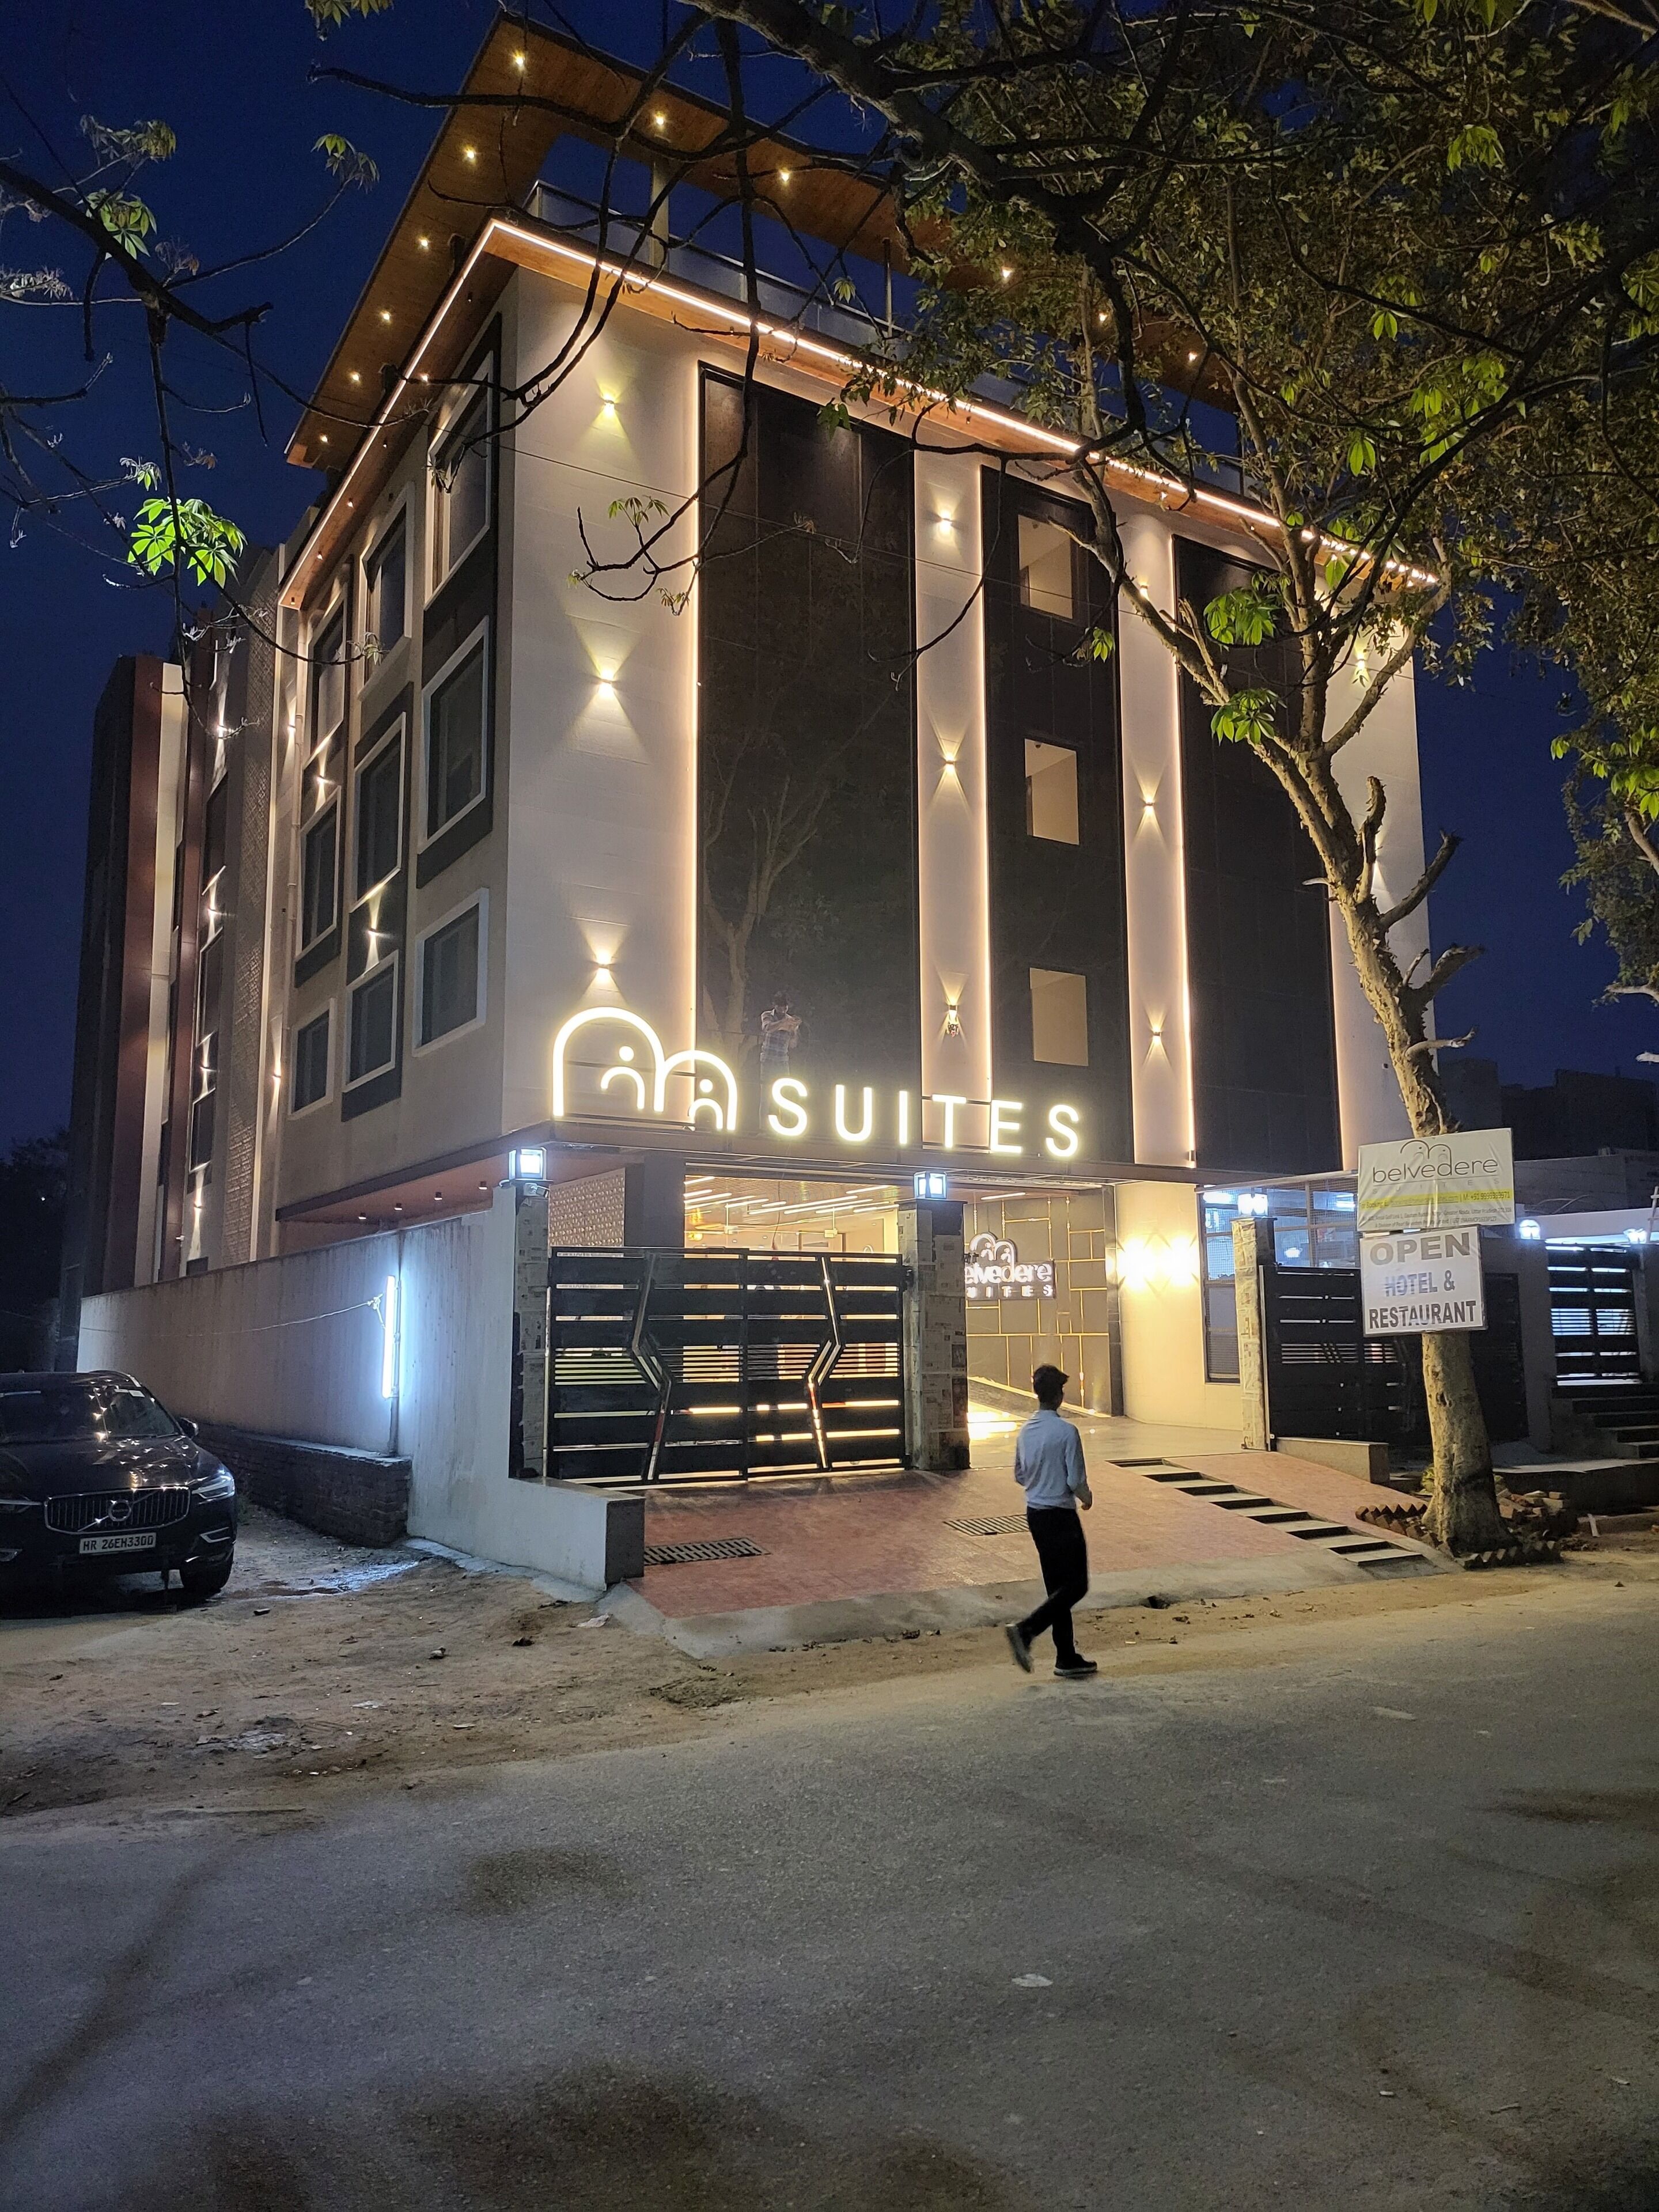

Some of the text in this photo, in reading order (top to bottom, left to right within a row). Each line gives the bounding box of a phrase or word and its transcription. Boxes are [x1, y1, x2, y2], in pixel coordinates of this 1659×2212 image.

[768, 1077, 1081, 1157] SUITES
[1373, 1157, 1498, 1183] belvedere
[1369, 1232, 1471, 1266] OPEN
[965, 1262, 1052, 1284] elvedere
[1384, 1270, 1456, 1297] HOTEL &
[967, 1285, 1054, 1298] UITES
[1369, 1300, 1477, 1329] RESTAURANT
[83, 1540, 97, 1551] HR
